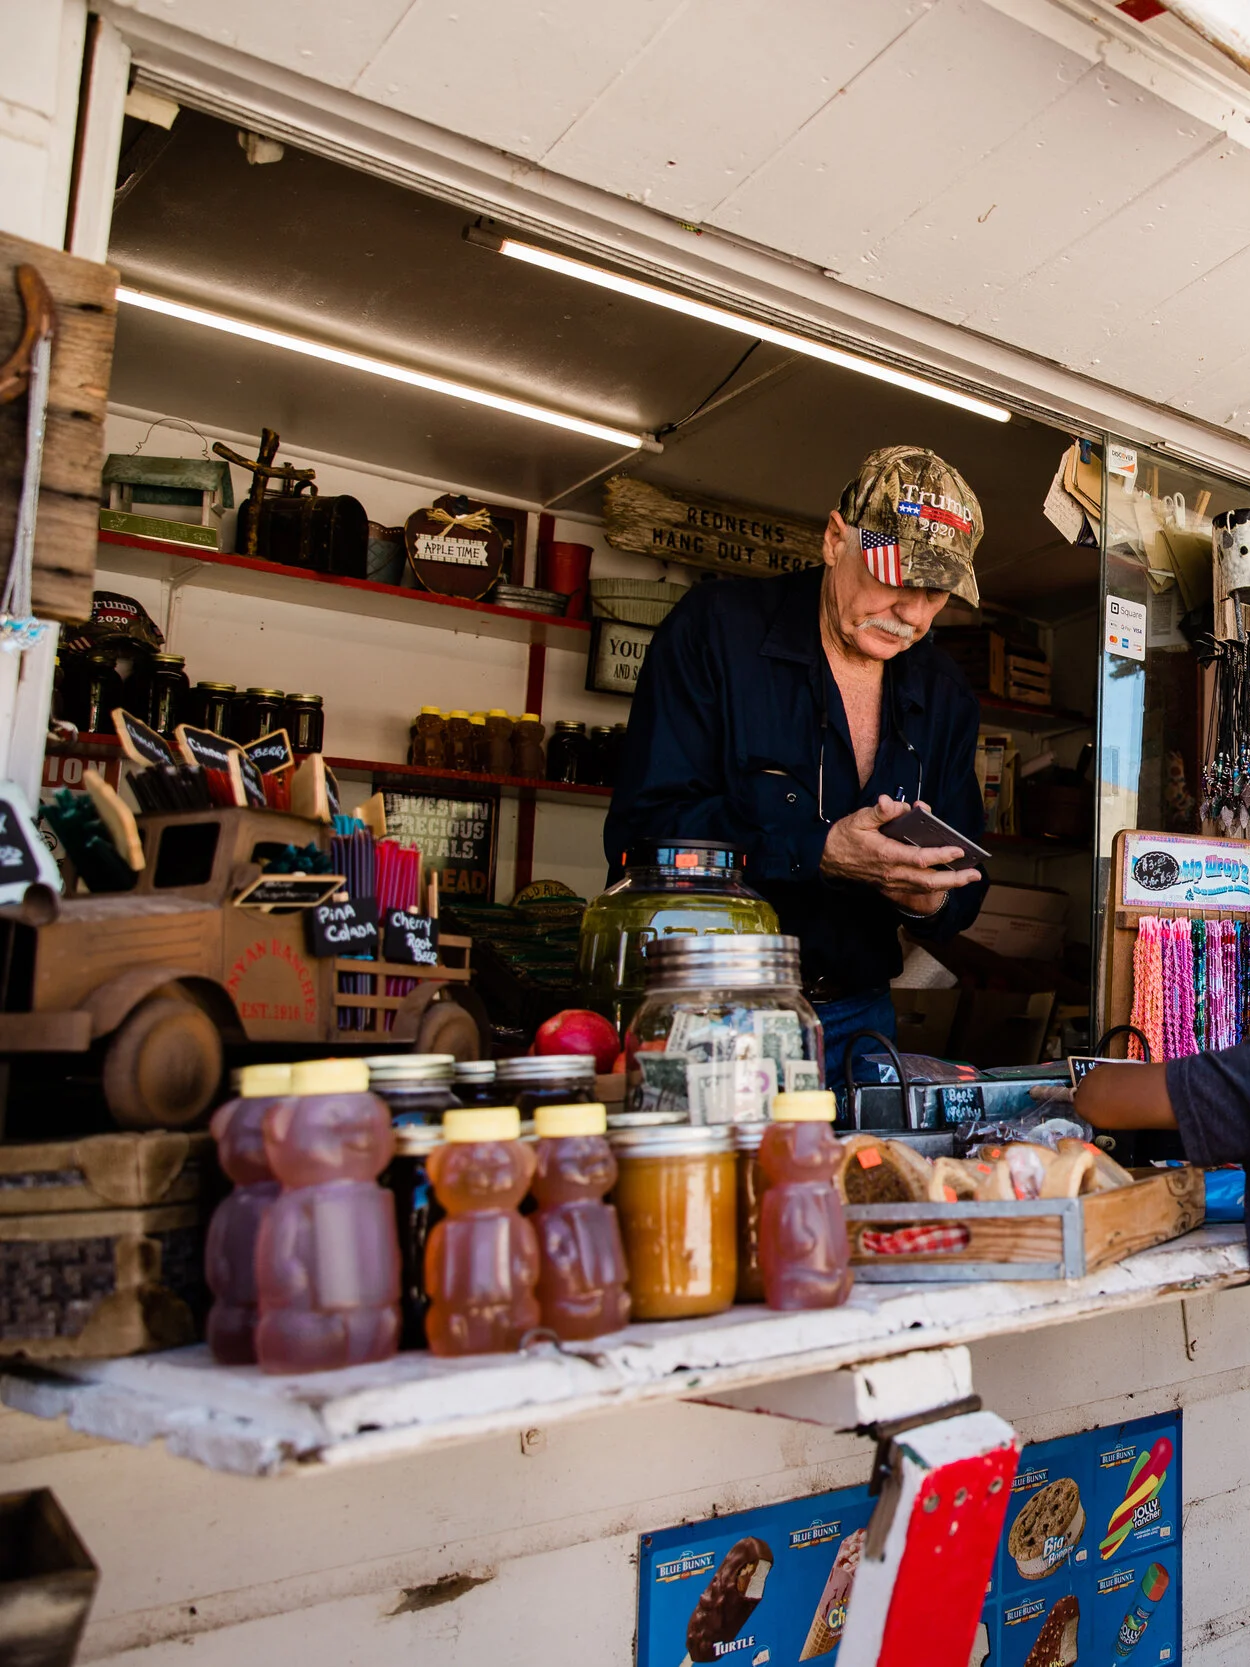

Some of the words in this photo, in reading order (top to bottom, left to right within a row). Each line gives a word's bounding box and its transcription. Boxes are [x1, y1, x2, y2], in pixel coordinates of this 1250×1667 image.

[902, 484, 972, 525] Trump
[687, 507, 785, 543] REDNECKS
[919, 518, 956, 539] 2020
[424, 542, 454, 555] APPLE
[456, 546, 480, 559] TIME
[652, 528, 704, 553] HANG
[718, 543, 756, 564] OUT
[92, 600, 138, 615] rump
[1120, 606, 1143, 620] Square
[97, 615, 129, 625] 2020
[614, 664, 630, 680] AND
[47, 756, 107, 785] ION
[386, 793, 458, 818] INVEST
[467, 801, 489, 821] IN
[387, 814, 485, 840] PRECIOUS
[391, 911, 432, 937] Cherry
[406, 933, 433, 950] Root
[1102, 1453, 1116, 1464] BLUE
[1116, 1449, 1135, 1460] BUNNY
[1026, 1472, 1047, 1484] BUNNY
[1133, 1498, 1159, 1522] JOLLY
[1134, 1508, 1161, 1528] rancher
[793, 1531, 812, 1543] BLUE
[812, 1524, 839, 1539] BUNNY
[1044, 1536, 1065, 1558] Big
[660, 1563, 682, 1577] BLUE
[682, 1556, 712, 1571] BUNNY
[1099, 1579, 1114, 1590] BLUE
[1113, 1573, 1134, 1585] BUNNY
[1007, 1609, 1022, 1621] BLUE
[1022, 1602, 1044, 1613] BUNNY
